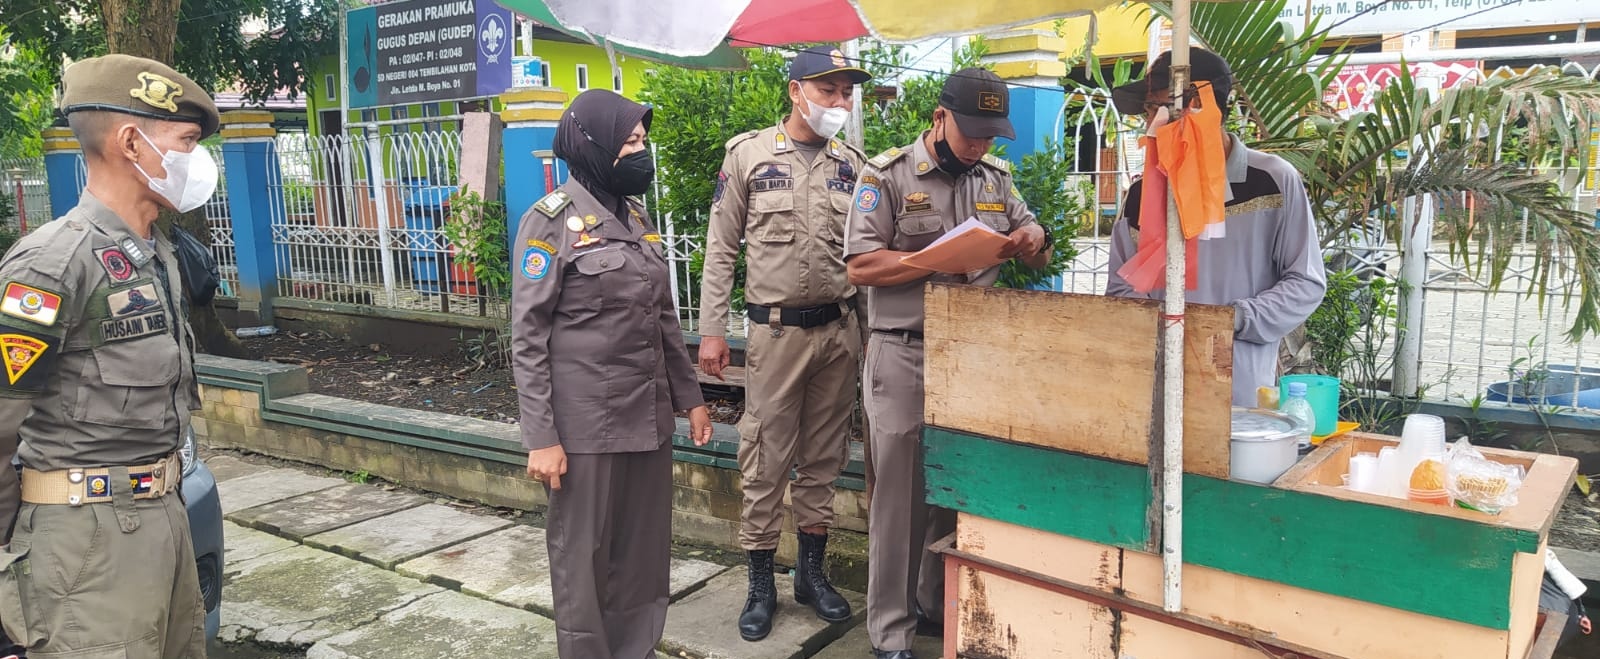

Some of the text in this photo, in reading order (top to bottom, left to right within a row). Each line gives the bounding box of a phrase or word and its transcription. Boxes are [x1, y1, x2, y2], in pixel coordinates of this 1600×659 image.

[378, 0, 474, 28] GERAKAN PRAMUKA
[1297, 4, 1332, 16] Ltda
[1337, 3, 1350, 14] M.
[1355, 1, 1387, 15] Boya
[1392, 0, 1413, 11] No.
[377, 24, 476, 50] GUGUS DEPAN (GUDEP)
[389, 56, 398, 66] PA
[427, 51, 434, 61] PI
[439, 47, 463, 59] 02/048
[377, 73, 385, 82] SD
[385, 70, 407, 80] NEGERI
[419, 64, 458, 77] TEMBILAHAN
[459, 62, 477, 71] KOTA
[419, 83, 425, 92] M.
[427, 82, 441, 92] Boya
[442, 80, 452, 89] No.
[453, 79, 460, 88] 01
[103, 317, 144, 339] HUSAINI
